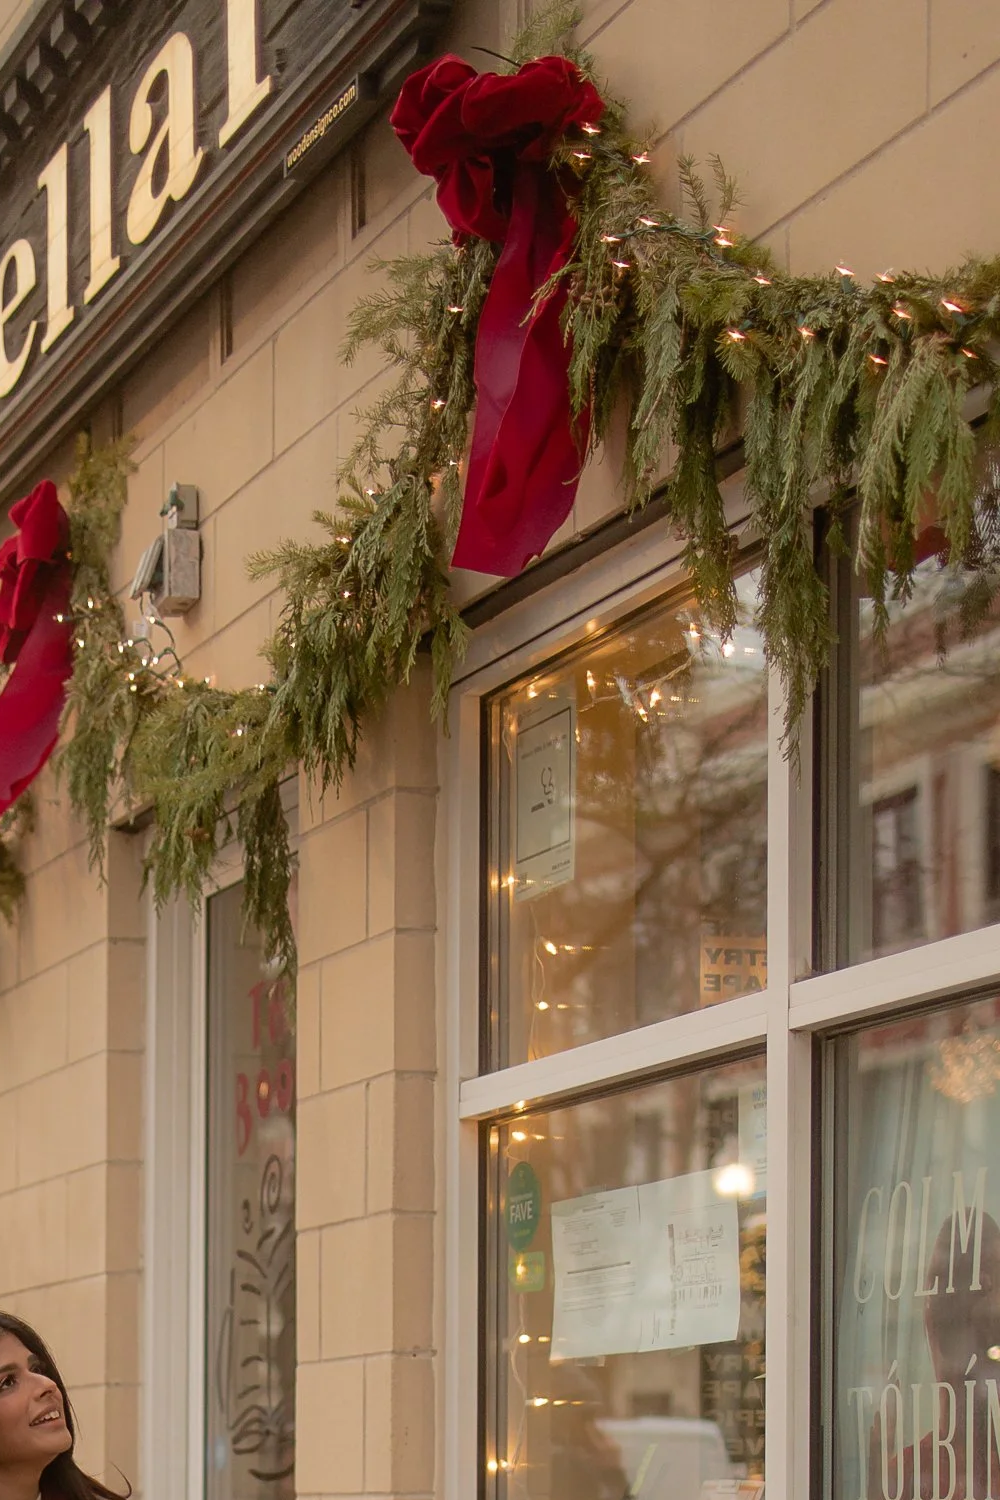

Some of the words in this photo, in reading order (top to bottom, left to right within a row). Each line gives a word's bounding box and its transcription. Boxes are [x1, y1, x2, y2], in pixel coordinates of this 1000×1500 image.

[287, 85, 356, 168] woodensignco.com
[236, 1058, 294, 1157] BOO
[509, 1200, 533, 1225] FAVE
[853, 1166, 988, 1304] COLM
